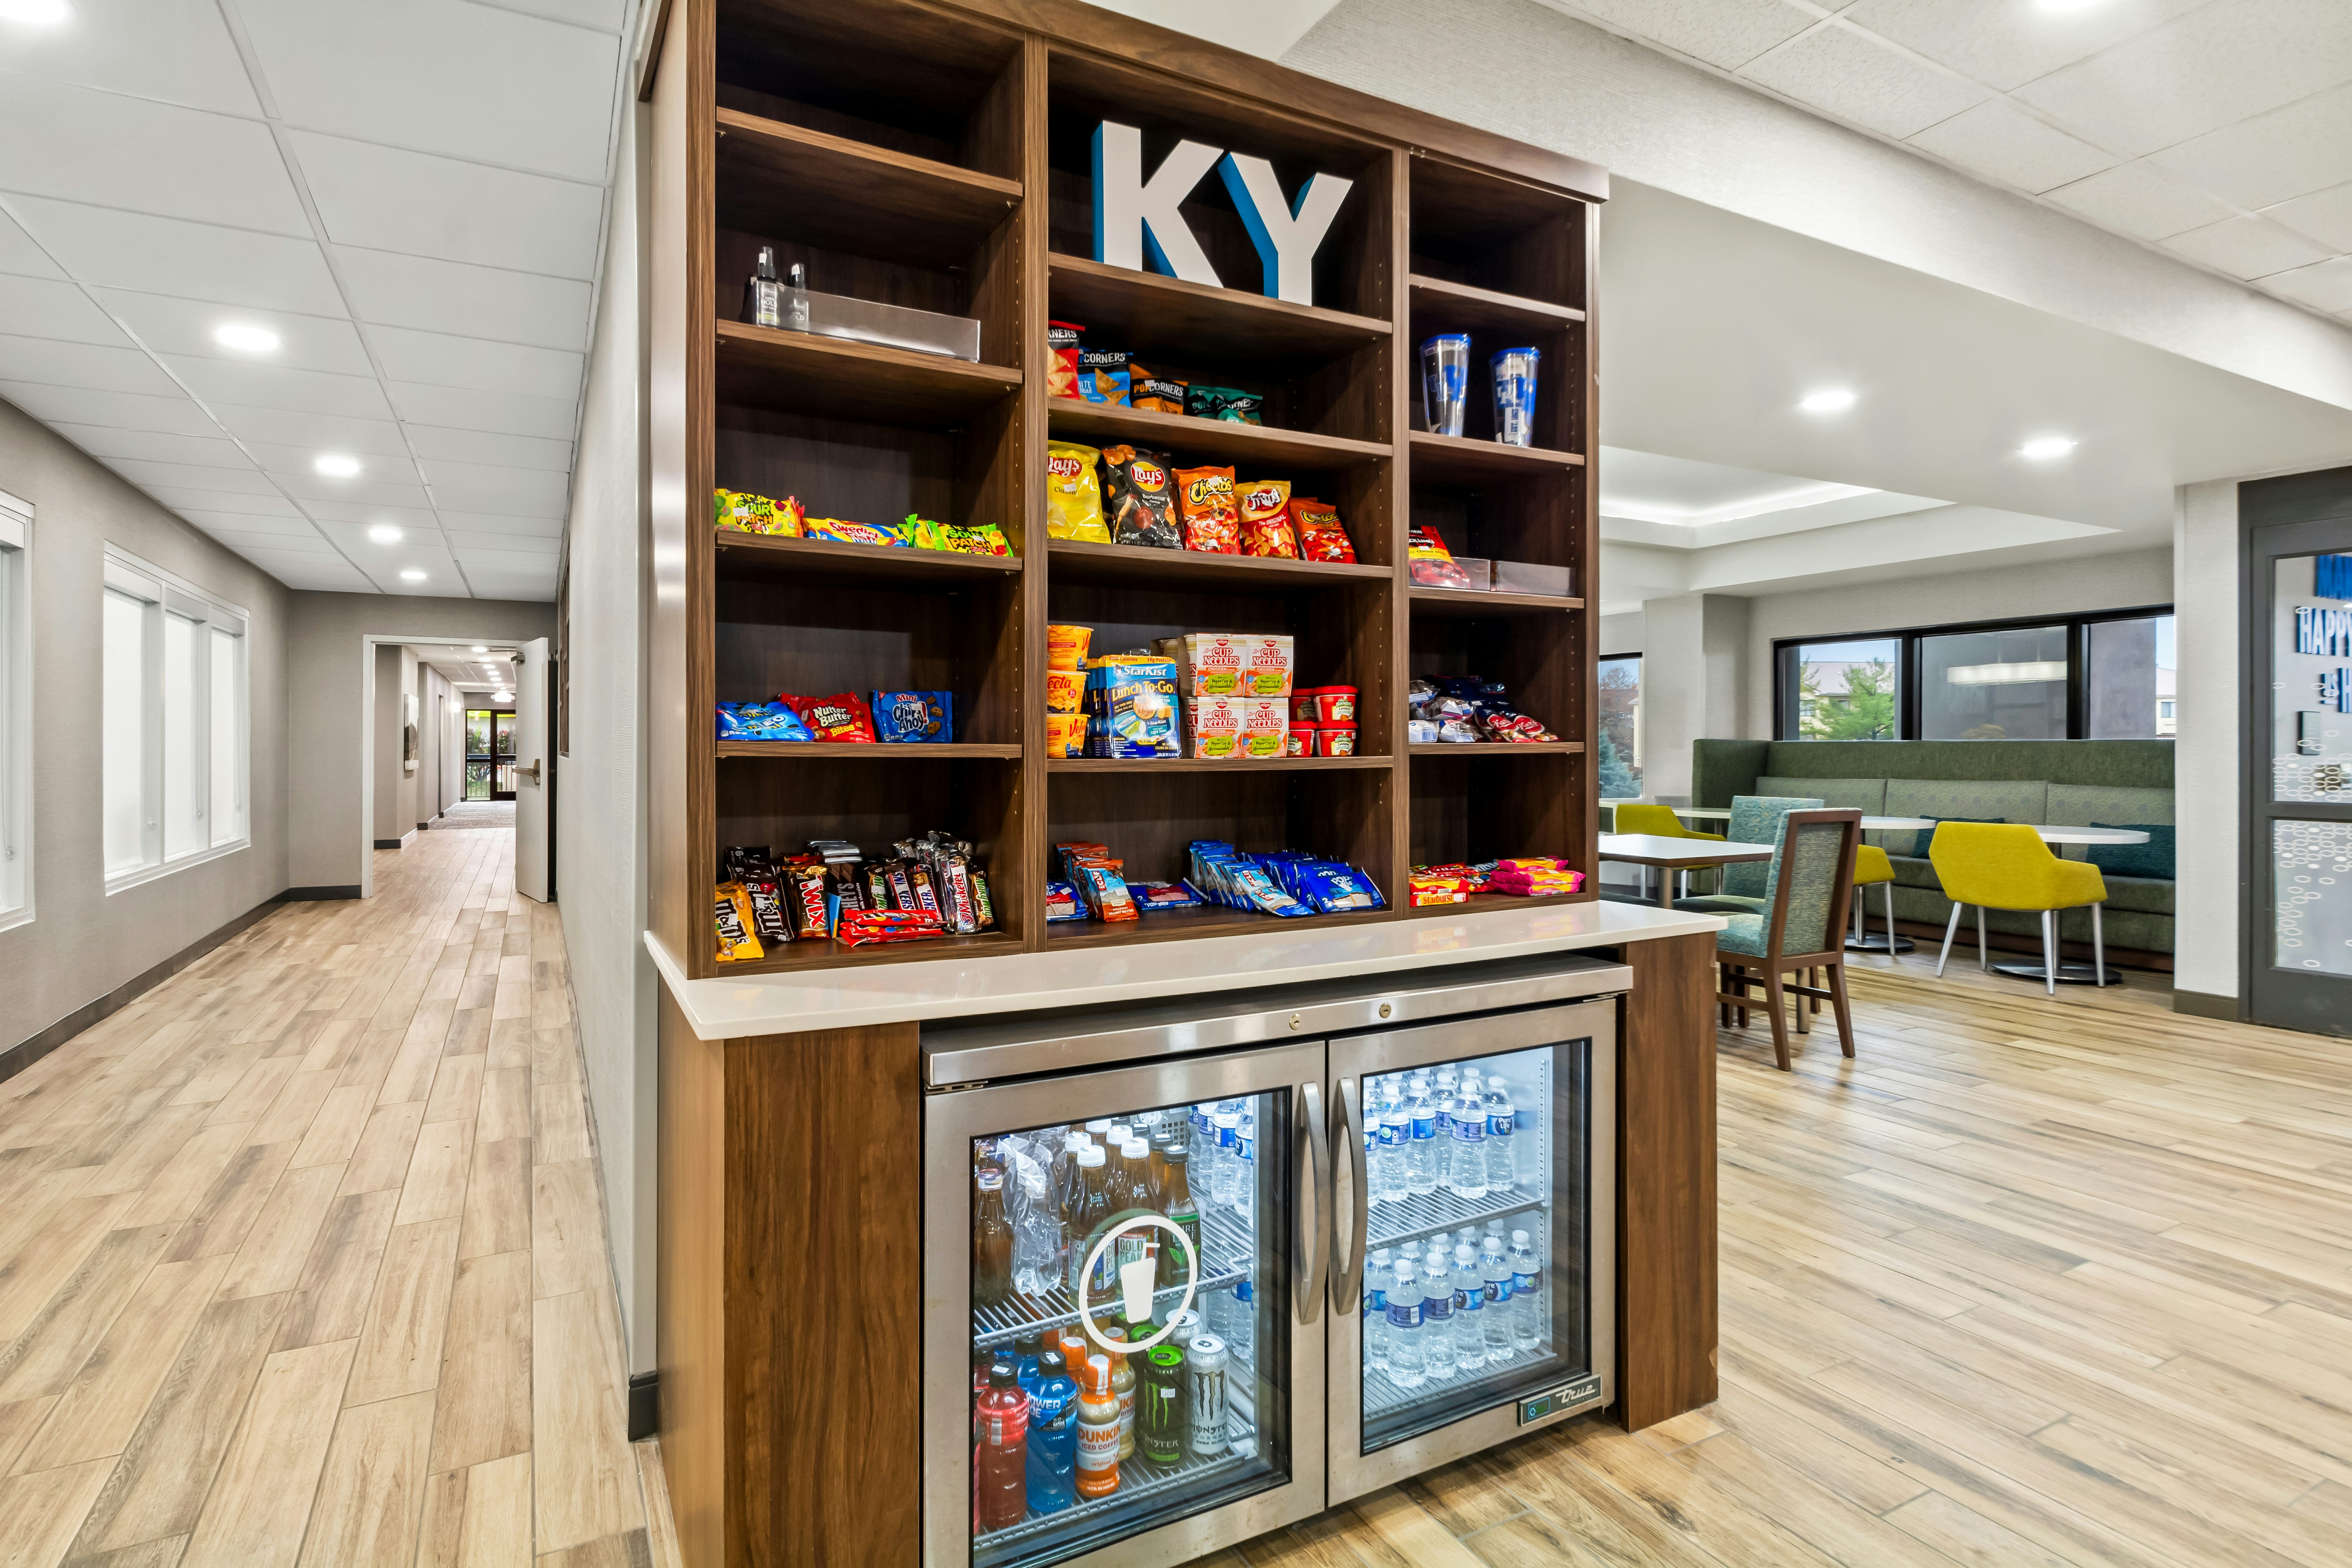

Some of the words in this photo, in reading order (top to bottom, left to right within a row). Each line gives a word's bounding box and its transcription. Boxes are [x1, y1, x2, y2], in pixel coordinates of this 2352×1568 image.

[1091, 120, 1353, 307] KY
[761, 299, 778, 307] HOLD
[1048, 457, 1080, 477] Lay's
[1132, 465, 1162, 485] Lay's
[1266, 514, 1287, 525] ORIGINAL
[949, 538, 993, 548] PATCH
[1212, 648, 1233, 657] CUP
[1260, 648, 1280, 658] CUP
[1203, 656, 1240, 666] NOODLES
[1252, 656, 1287, 666] NOODLES
[1123, 666, 1167, 676] StarKist
[1112, 682, 1143, 702] Lunch
[896, 694, 917, 703] Mini
[813, 706, 846, 718] Nutter
[1212, 710, 1231, 719] CUP
[1256, 710, 1276, 720] CUP
[819, 713, 851, 727] Butter
[1203, 718, 1238, 728] NOODLES
[1247, 718, 1282, 729] NOODLES
[829, 724, 855, 737] Bites
[1093, 871, 1104, 886] CLIF
[893, 873, 916, 910] SNIKERS
[951, 864, 972, 914] Musketees
[800, 875, 826, 928] TWIX
[1423, 893, 1453, 904] Starburst
[1120, 1239, 1143, 1251] GOLD
[1027, 1391, 1061, 1409] POWER
